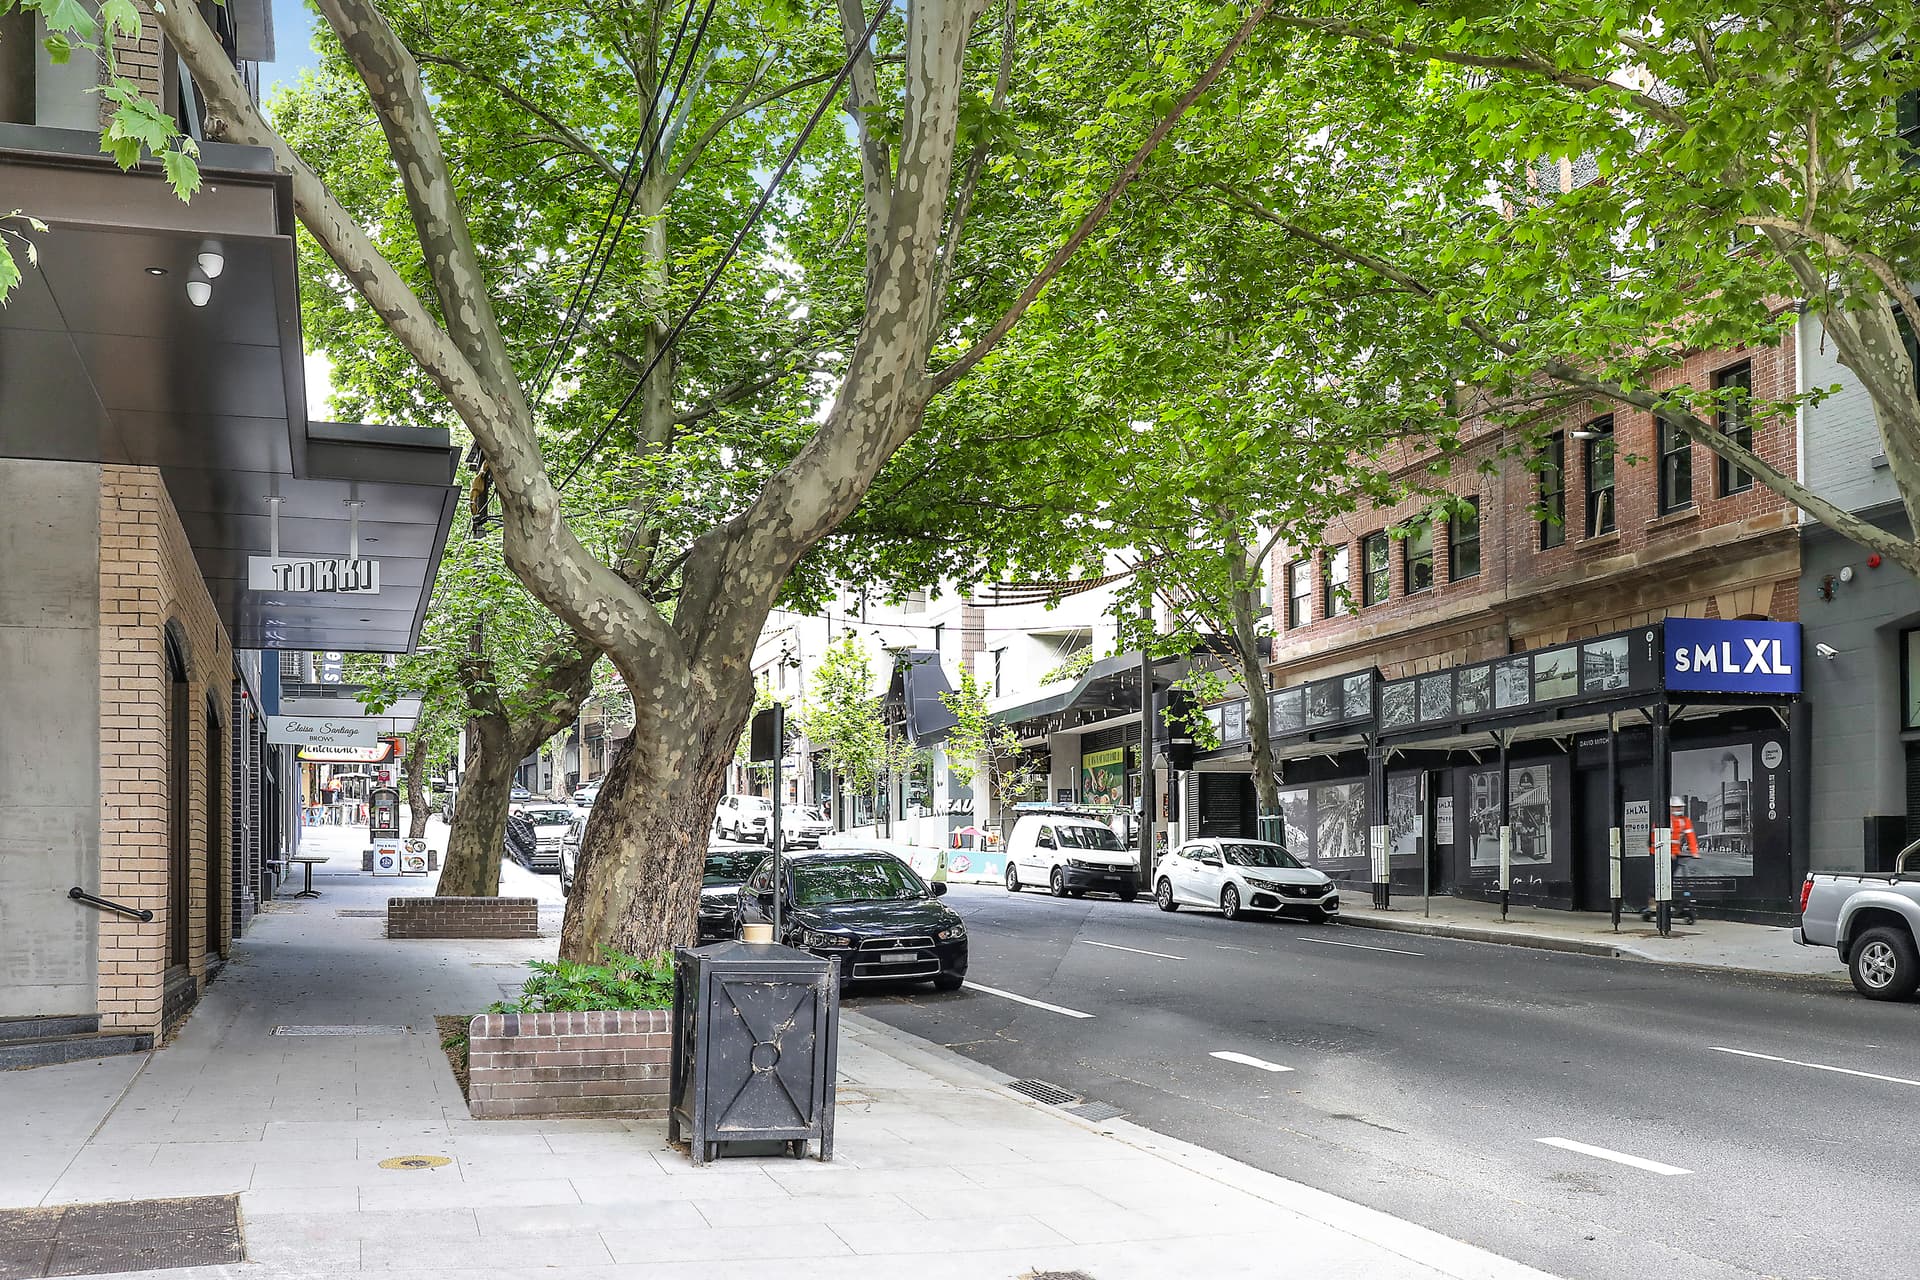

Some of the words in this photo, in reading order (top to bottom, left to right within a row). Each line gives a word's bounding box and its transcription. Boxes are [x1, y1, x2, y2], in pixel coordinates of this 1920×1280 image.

[1674, 637, 1792, 675] SMLXL
[285, 721, 313, 733] Eloisa
[320, 722, 359, 737] Santiago
